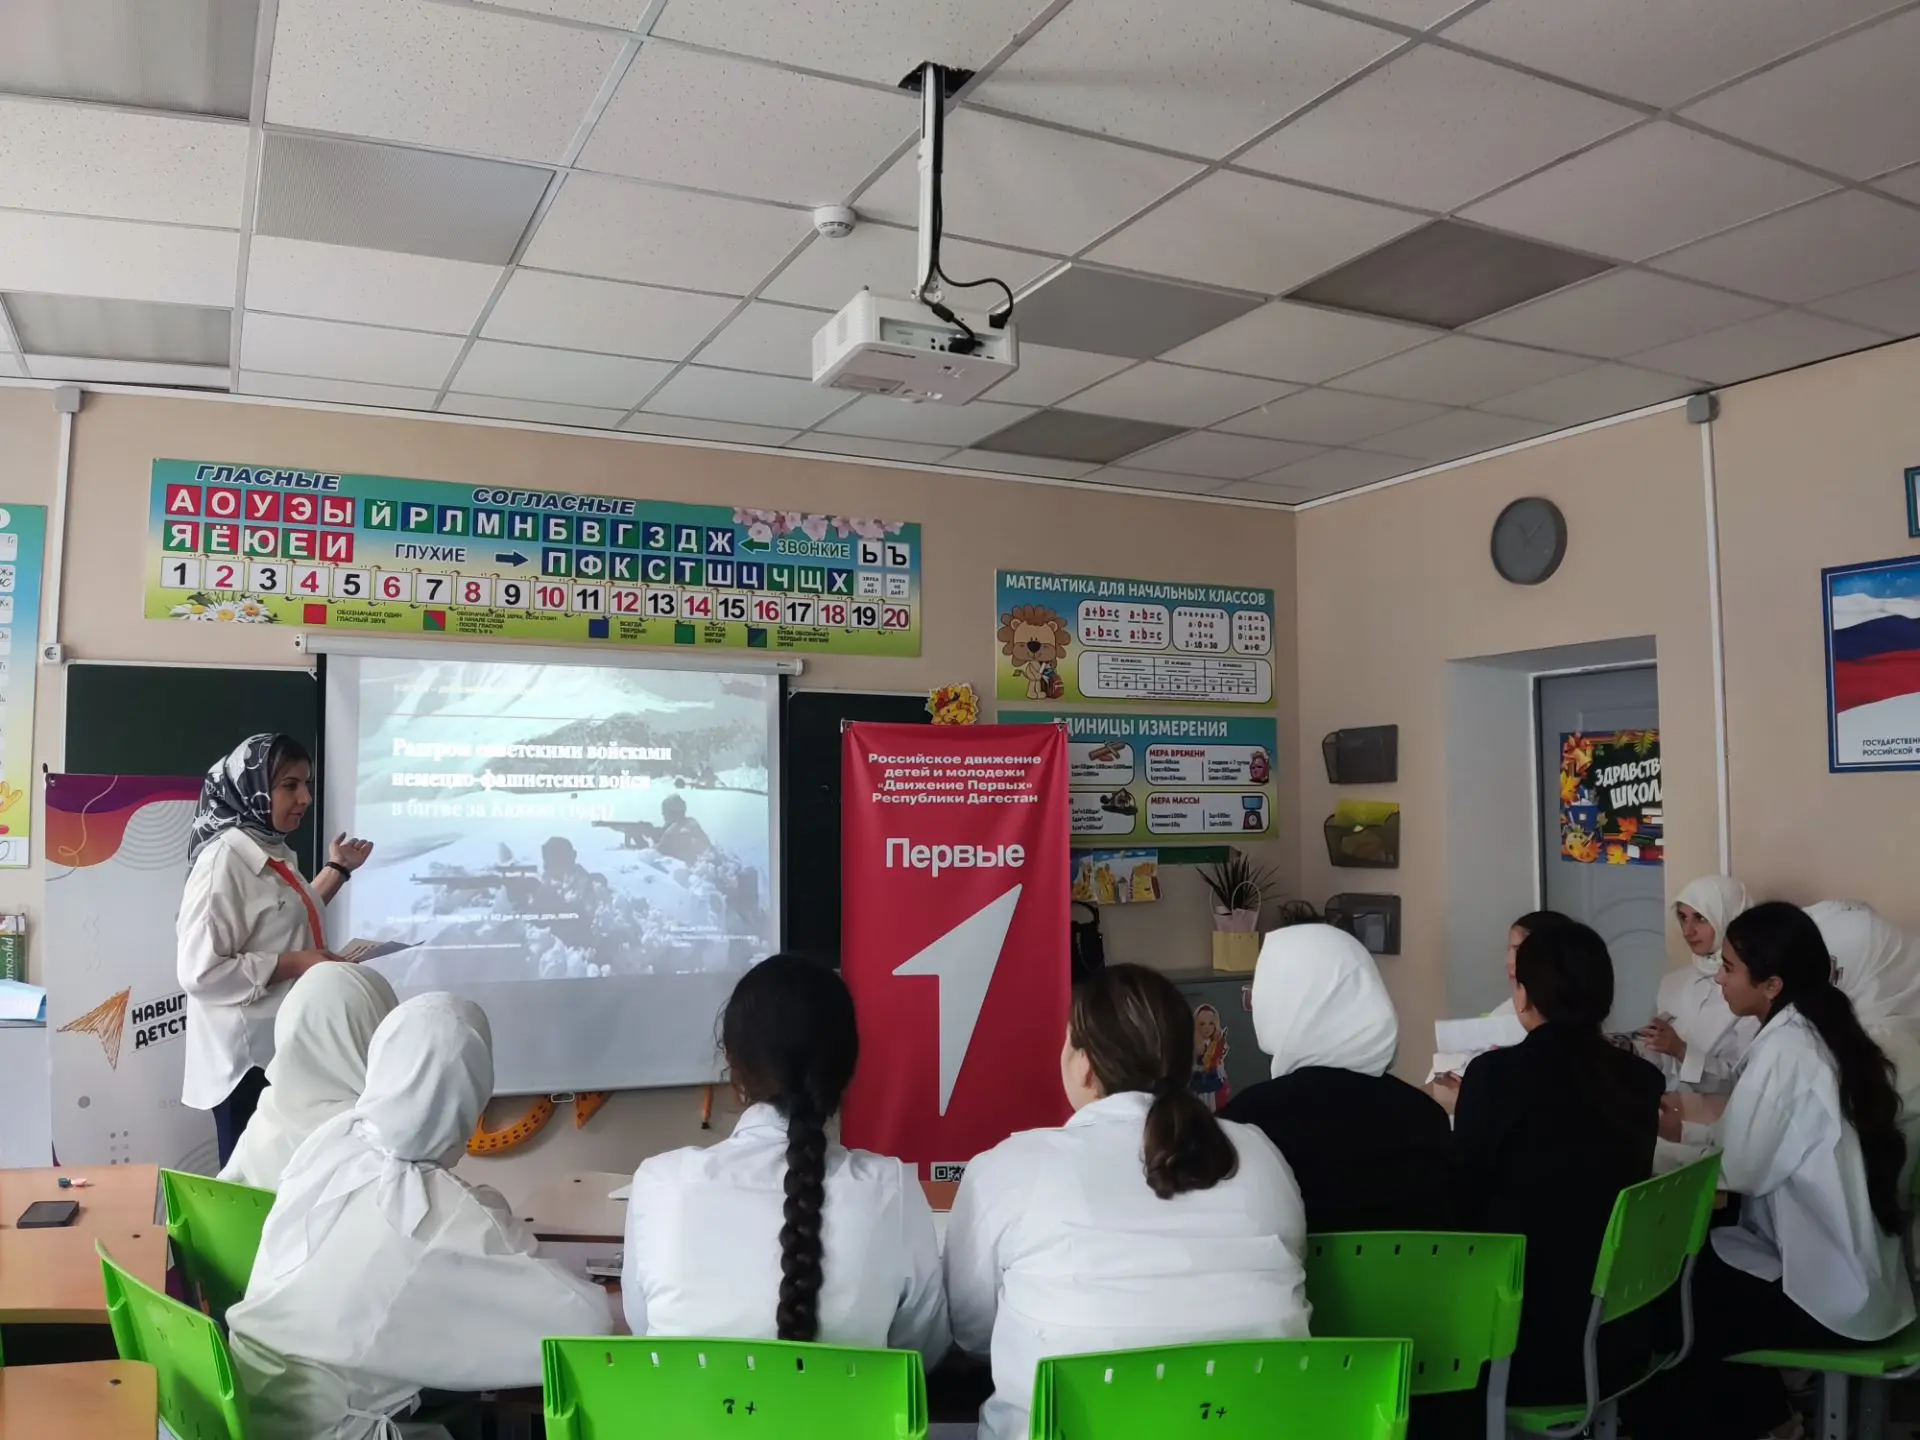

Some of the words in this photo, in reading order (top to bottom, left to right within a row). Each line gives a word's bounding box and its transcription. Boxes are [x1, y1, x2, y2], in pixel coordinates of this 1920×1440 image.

[196, 465, 340, 491] ГЛАСНЫЕ
[171, 489, 194, 513] А
[211, 491, 235, 515] О
[252, 494, 273, 518] У
[290, 497, 312, 520] Э
[323, 499, 352, 524] Ы
[472, 488, 636, 516] СОГЛАСНЫЕ
[371, 501, 391, 527] Й
[409, 507, 428, 529] Р
[442, 510, 462, 533] Л
[477, 512, 500, 535] М
[514, 515, 533, 538] Н
[549, 518, 567, 540] Б
[582, 521, 601, 543] В
[618, 524, 633, 545] Г
[649, 526, 665, 548] З
[677, 529, 698, 553] Д
[708, 531, 732, 553] Ж
[169, 524, 192, 548] Я
[210, 525, 231, 551] Ё
[244, 529, 275, 553] Ю
[289, 532, 309, 556] Е
[326, 535, 347, 559] И
[395, 543, 466, 562] ГЛУХИЕ
[776, 538, 851, 560] ЗВОНКИЕ
[862, 543, 878, 564] Ь
[887, 545, 907, 566] Ъ
[548, 551, 566, 574] П
[579, 554, 602, 576] Ф
[615, 556, 631, 578] К
[648, 559, 665, 581] С
[680, 561, 696, 582] Т
[708, 563, 732, 586] Ш
[742, 565, 758, 588] Ц
[773, 567, 789, 589] Ч
[801, 570, 823, 592] Щ
[832, 571, 848, 593] Х
[173, 562, 187, 585] 1
[215, 565, 234, 588] 2
[259, 568, 277, 591] 3
[300, 570, 319, 593] 4
[343, 573, 361, 596] 5
[383, 576, 401, 598] 6
[426, 579, 444, 601] 7
[464, 581, 481, 603] 8
[504, 584, 521, 605] 9
[536, 586, 565, 608] 10
[576, 588, 599, 610] 11
[612, 591, 639, 612] 12
[648, 593, 675, 615] 13
[684, 595, 711, 617] 14
[718, 597, 745, 619] 15
[753, 600, 780, 621] 16
[786, 602, 812, 622] 17
[820, 604, 846, 624] 18
[851, 606, 876, 626] 19
[883, 607, 909, 628] 20
[1006, 574, 1096, 595] МАТЕМАТИКА
[1098, 581, 1125, 597] ДЛЯ
[1128, 583, 1205, 602] НАЧАЛЬНЫХ
[1209, 590, 1266, 606] КЛАССОВ
[336, 609, 383, 618] ОБОЗНАЧАЮТ
[336, 615, 369, 623] ГЛАСНЫЙ
[1139, 719, 1228, 737] ИЗМЕРЕНИЯ
[586, 741, 672, 761] войсками
[868, 753, 962, 764] Российское
[964, 755, 1042, 766] движение
[1149, 749, 1169, 757] МЕРА
[1170, 749, 1205, 758] ВРЕМЕНИ
[1863, 746, 1913, 756] РОССИЙСКОЙ
[391, 769, 595, 792] немецко-фашистских
[884, 766, 931, 778] детей
[932, 768, 943, 777] и
[946, 768, 1026, 778] молодежи
[1595, 757, 1660, 787] ЗДРАВСТВ
[877, 780, 965, 791] «Движение
[967, 781, 1033, 792] Первых»
[1610, 779, 1662, 810] ШКОЛ
[872, 793, 965, 805] Республики
[967, 794, 1038, 805] Дагестан
[1172, 796, 1200, 804] МАССЫ
[886, 837, 1026, 878] Первые
[131, 993, 187, 1025] НАВИГ
